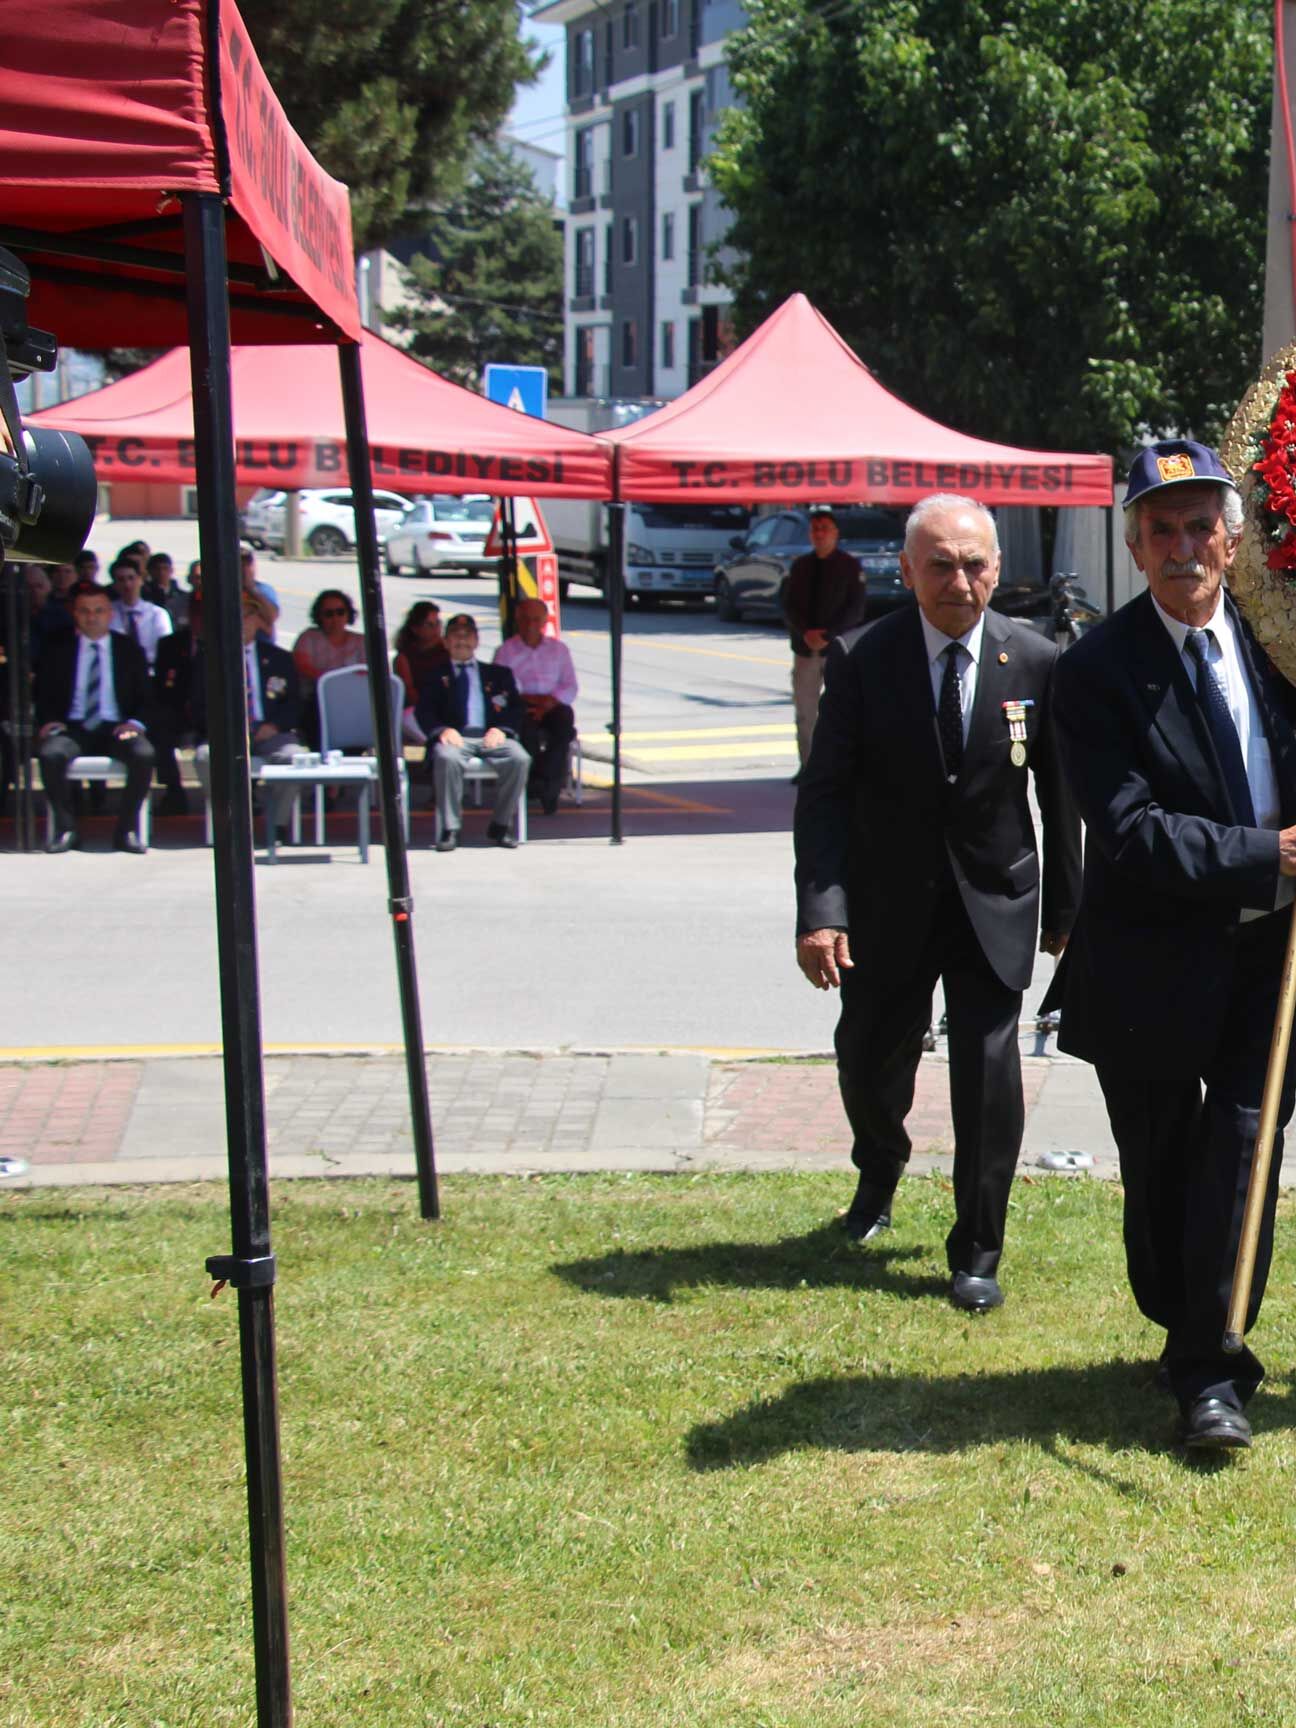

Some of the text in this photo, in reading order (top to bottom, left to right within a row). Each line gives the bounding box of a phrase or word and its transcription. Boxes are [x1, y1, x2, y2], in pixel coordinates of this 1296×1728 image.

[177, 438, 298, 470] BLU
[314, 444, 564, 483] BLEDİYESİ
[671, 459, 1073, 492] T.C. BOLU BELEDİYESİ
